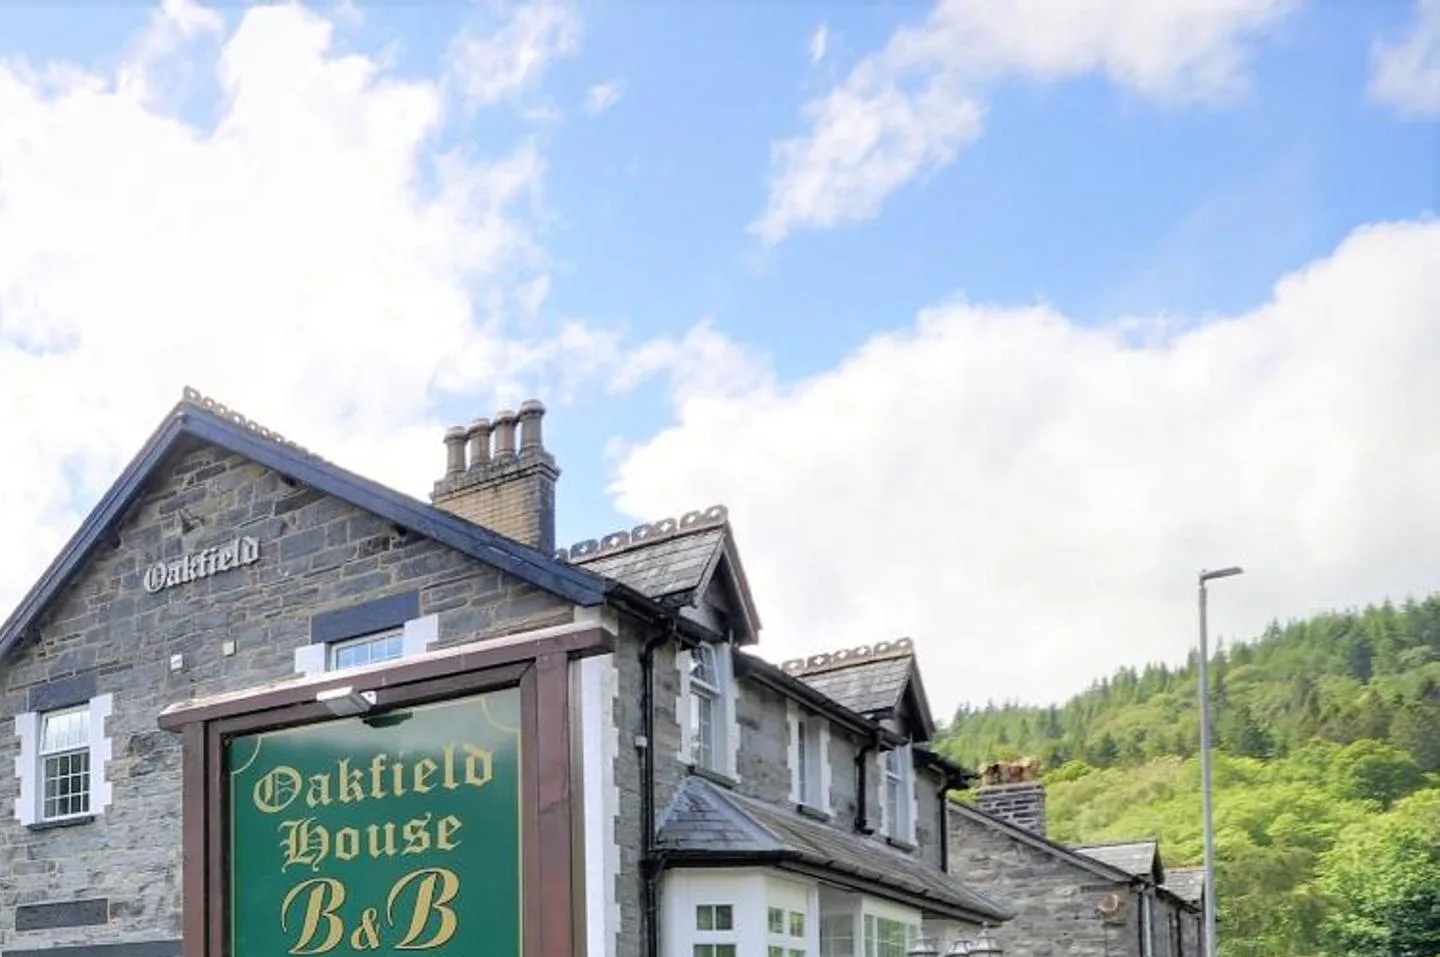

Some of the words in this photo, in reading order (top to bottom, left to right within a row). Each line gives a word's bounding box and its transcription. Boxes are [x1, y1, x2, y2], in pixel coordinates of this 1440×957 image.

[143, 534, 260, 593] Oakfield
[253, 742, 494, 813] Oakfield
[278, 811, 463, 873] House
